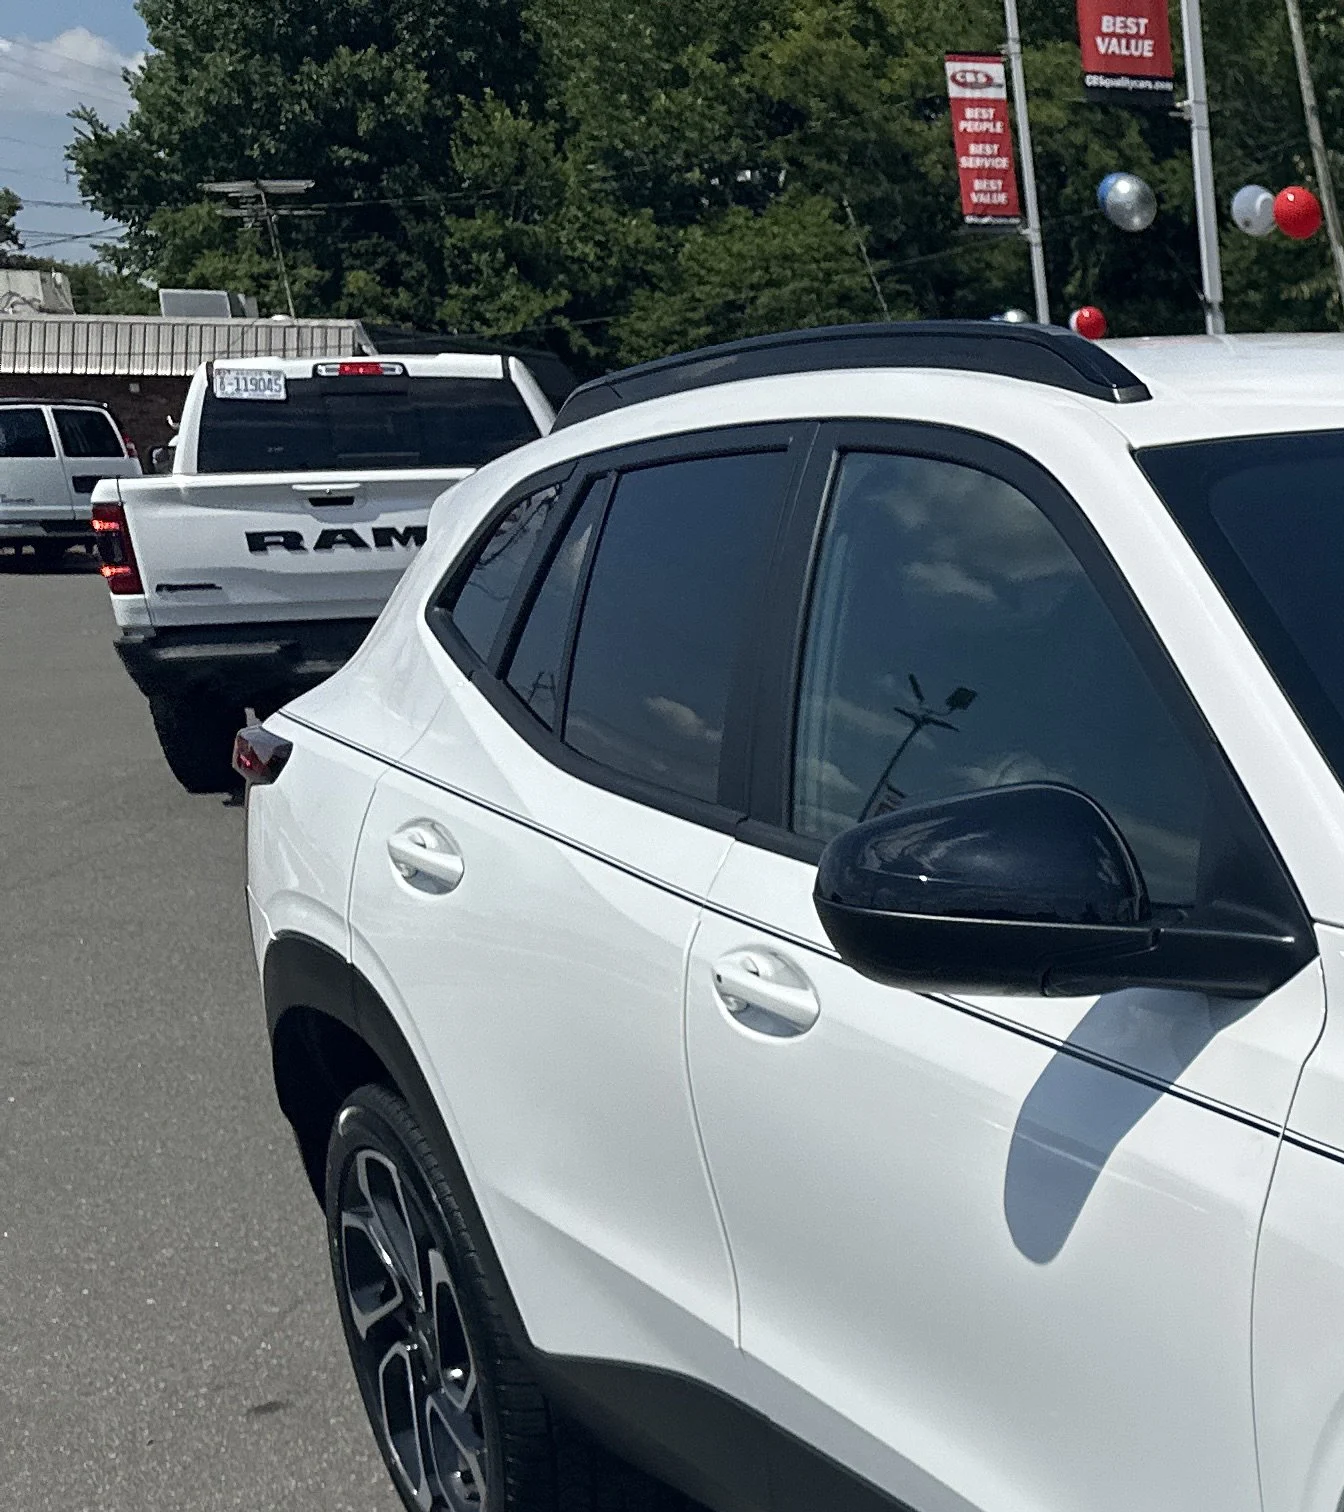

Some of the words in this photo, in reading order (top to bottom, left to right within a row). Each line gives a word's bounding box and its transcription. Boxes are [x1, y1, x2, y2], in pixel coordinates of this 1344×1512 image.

[1101, 15, 1148, 35] BEST
[1095, 36, 1154, 57] VALUE
[964, 107, 995, 120] BEST
[959, 121, 1004, 134] PEOPLE
[968, 143, 1000, 156] BEST
[958, 156, 1009, 170] SERVICE
[973, 178, 1003, 191] BEST
[969, 192, 1009, 205] VALUE
[245, 525, 428, 553] RAM
